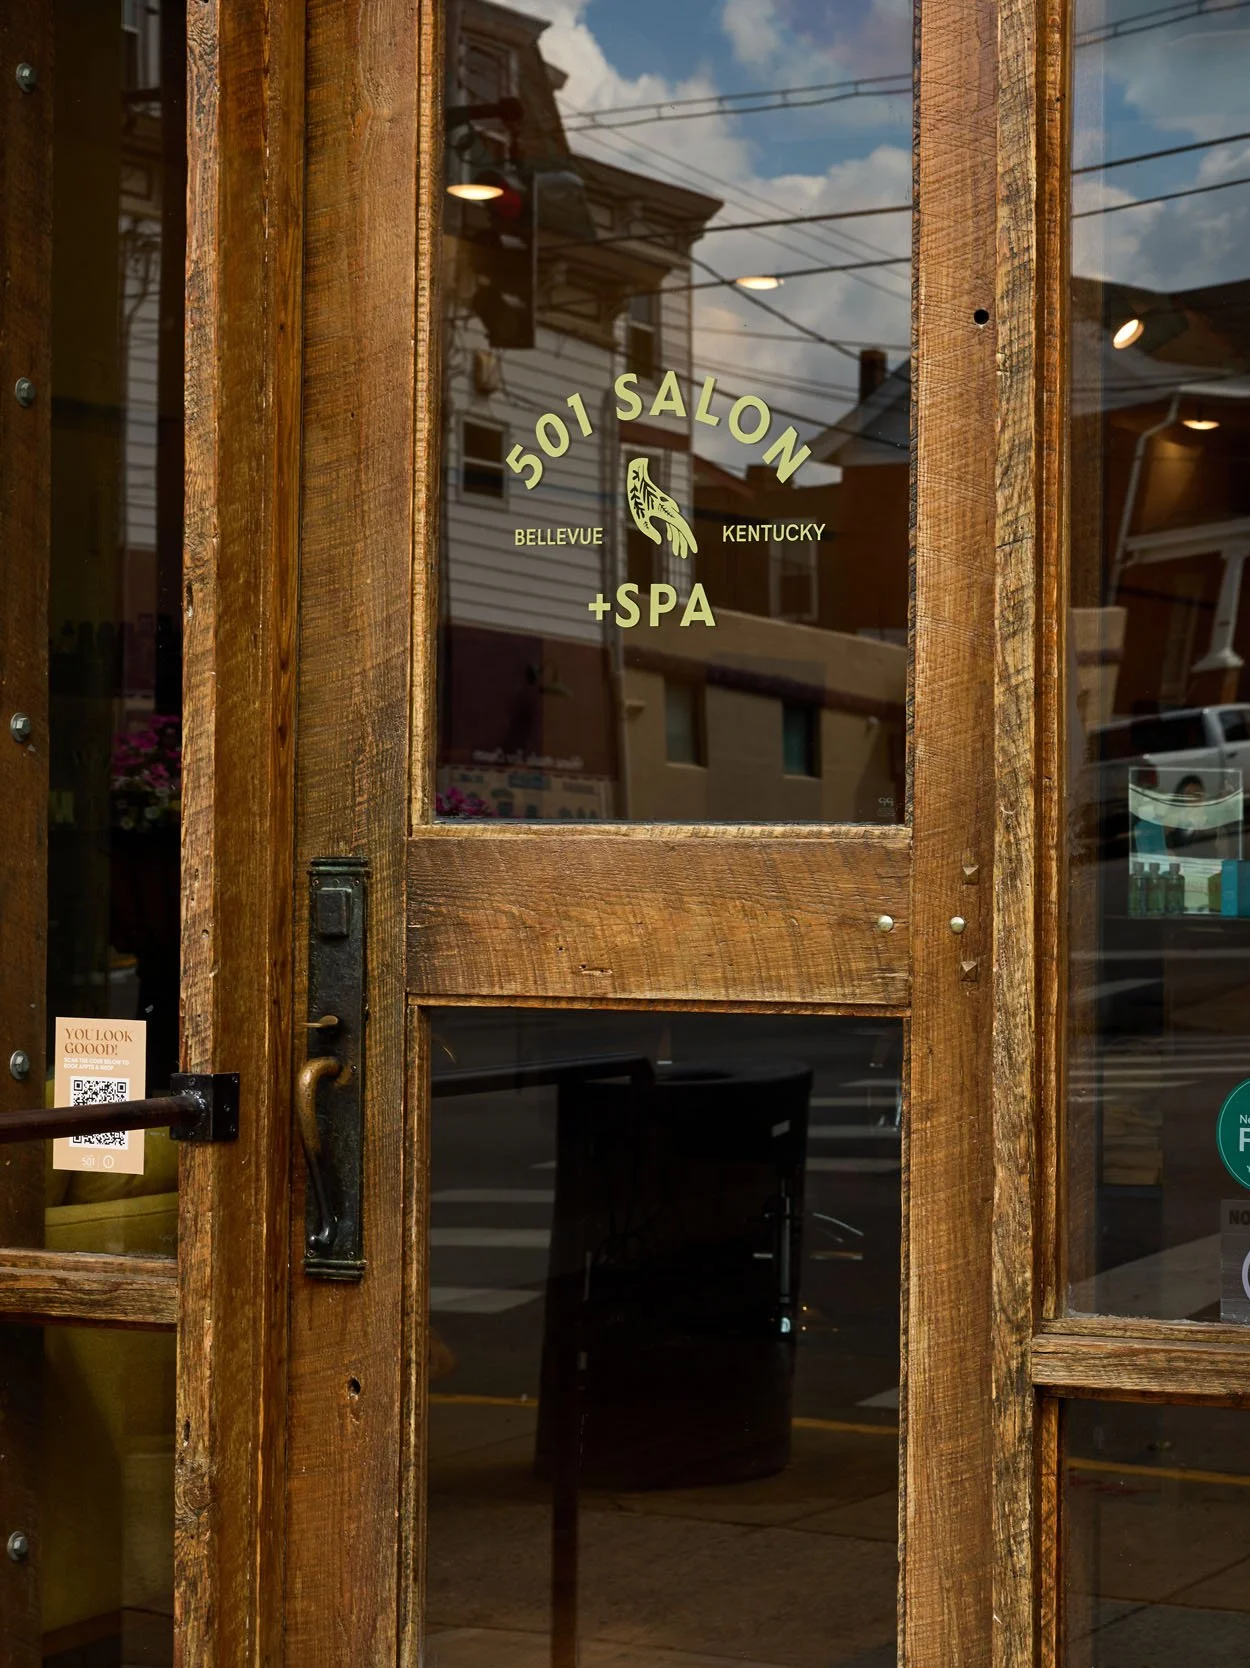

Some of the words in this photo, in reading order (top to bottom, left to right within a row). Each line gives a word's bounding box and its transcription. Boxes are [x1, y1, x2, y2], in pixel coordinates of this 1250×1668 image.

[506, 392, 593, 490] 501
[614, 370, 812, 484] SALON
[514, 527, 603, 546] BELLEVUE
[722, 523, 826, 542] KENTUCKY
[588, 582, 716, 628] +SPA
[65, 1028, 94, 1041] YOU
[96, 1029, 133, 1042] LOOK
[64, 1042, 118, 1056] GOOOD!
[1229, 1209, 1250, 1226] NO
